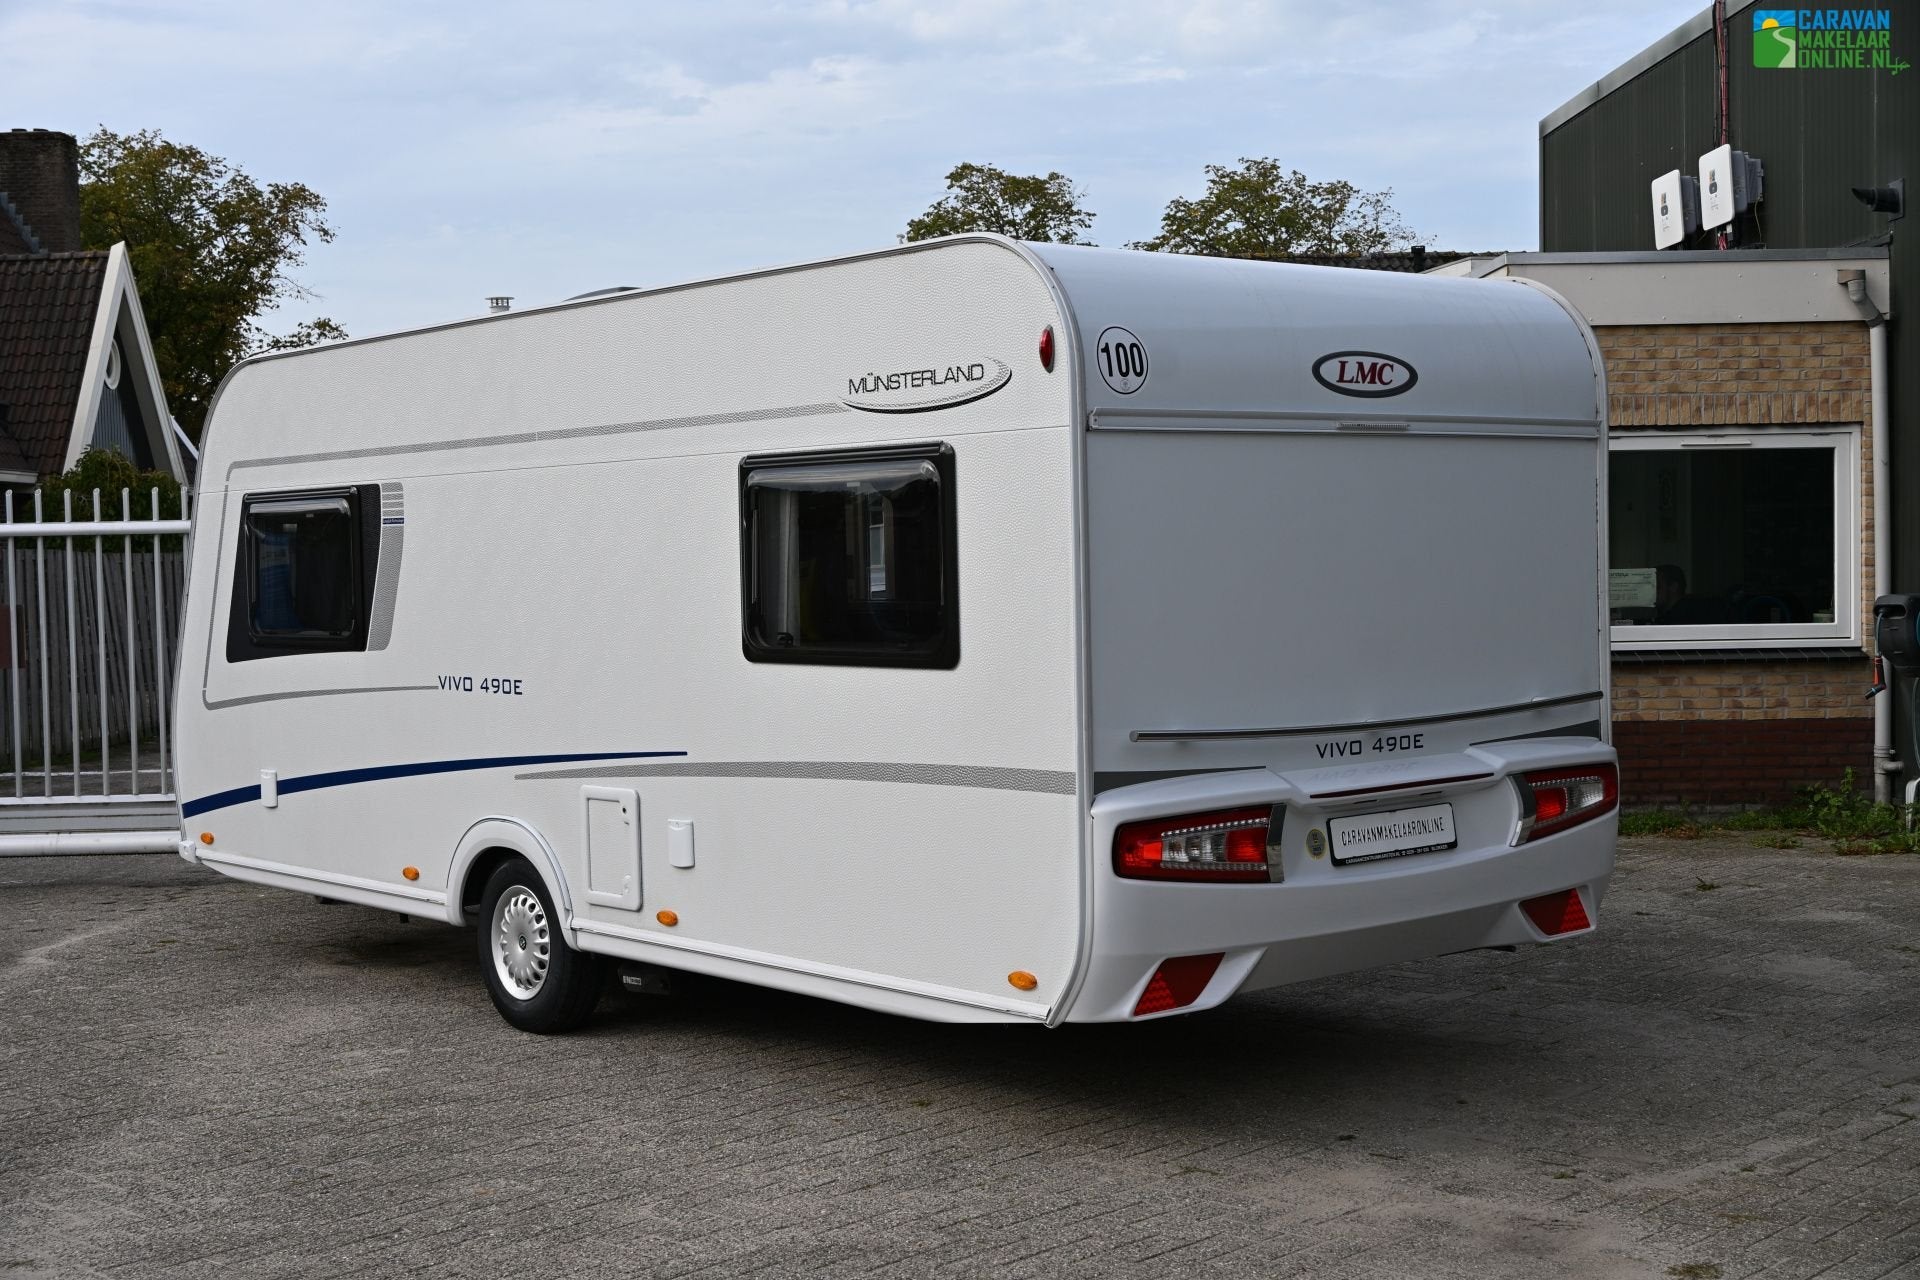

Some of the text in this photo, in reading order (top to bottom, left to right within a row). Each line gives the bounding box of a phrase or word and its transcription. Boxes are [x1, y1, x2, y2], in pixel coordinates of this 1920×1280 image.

[1100, 342, 1144, 377] 100
[1336, 360, 1394, 386] LMC
[848, 363, 984, 395] MÜNSTERLAND
[438, 675, 523, 695] VIVO 490E
[1316, 733, 1424, 758] VIVO 490E
[1341, 817, 1445, 846] CARAVANMAKELAARONLINE
